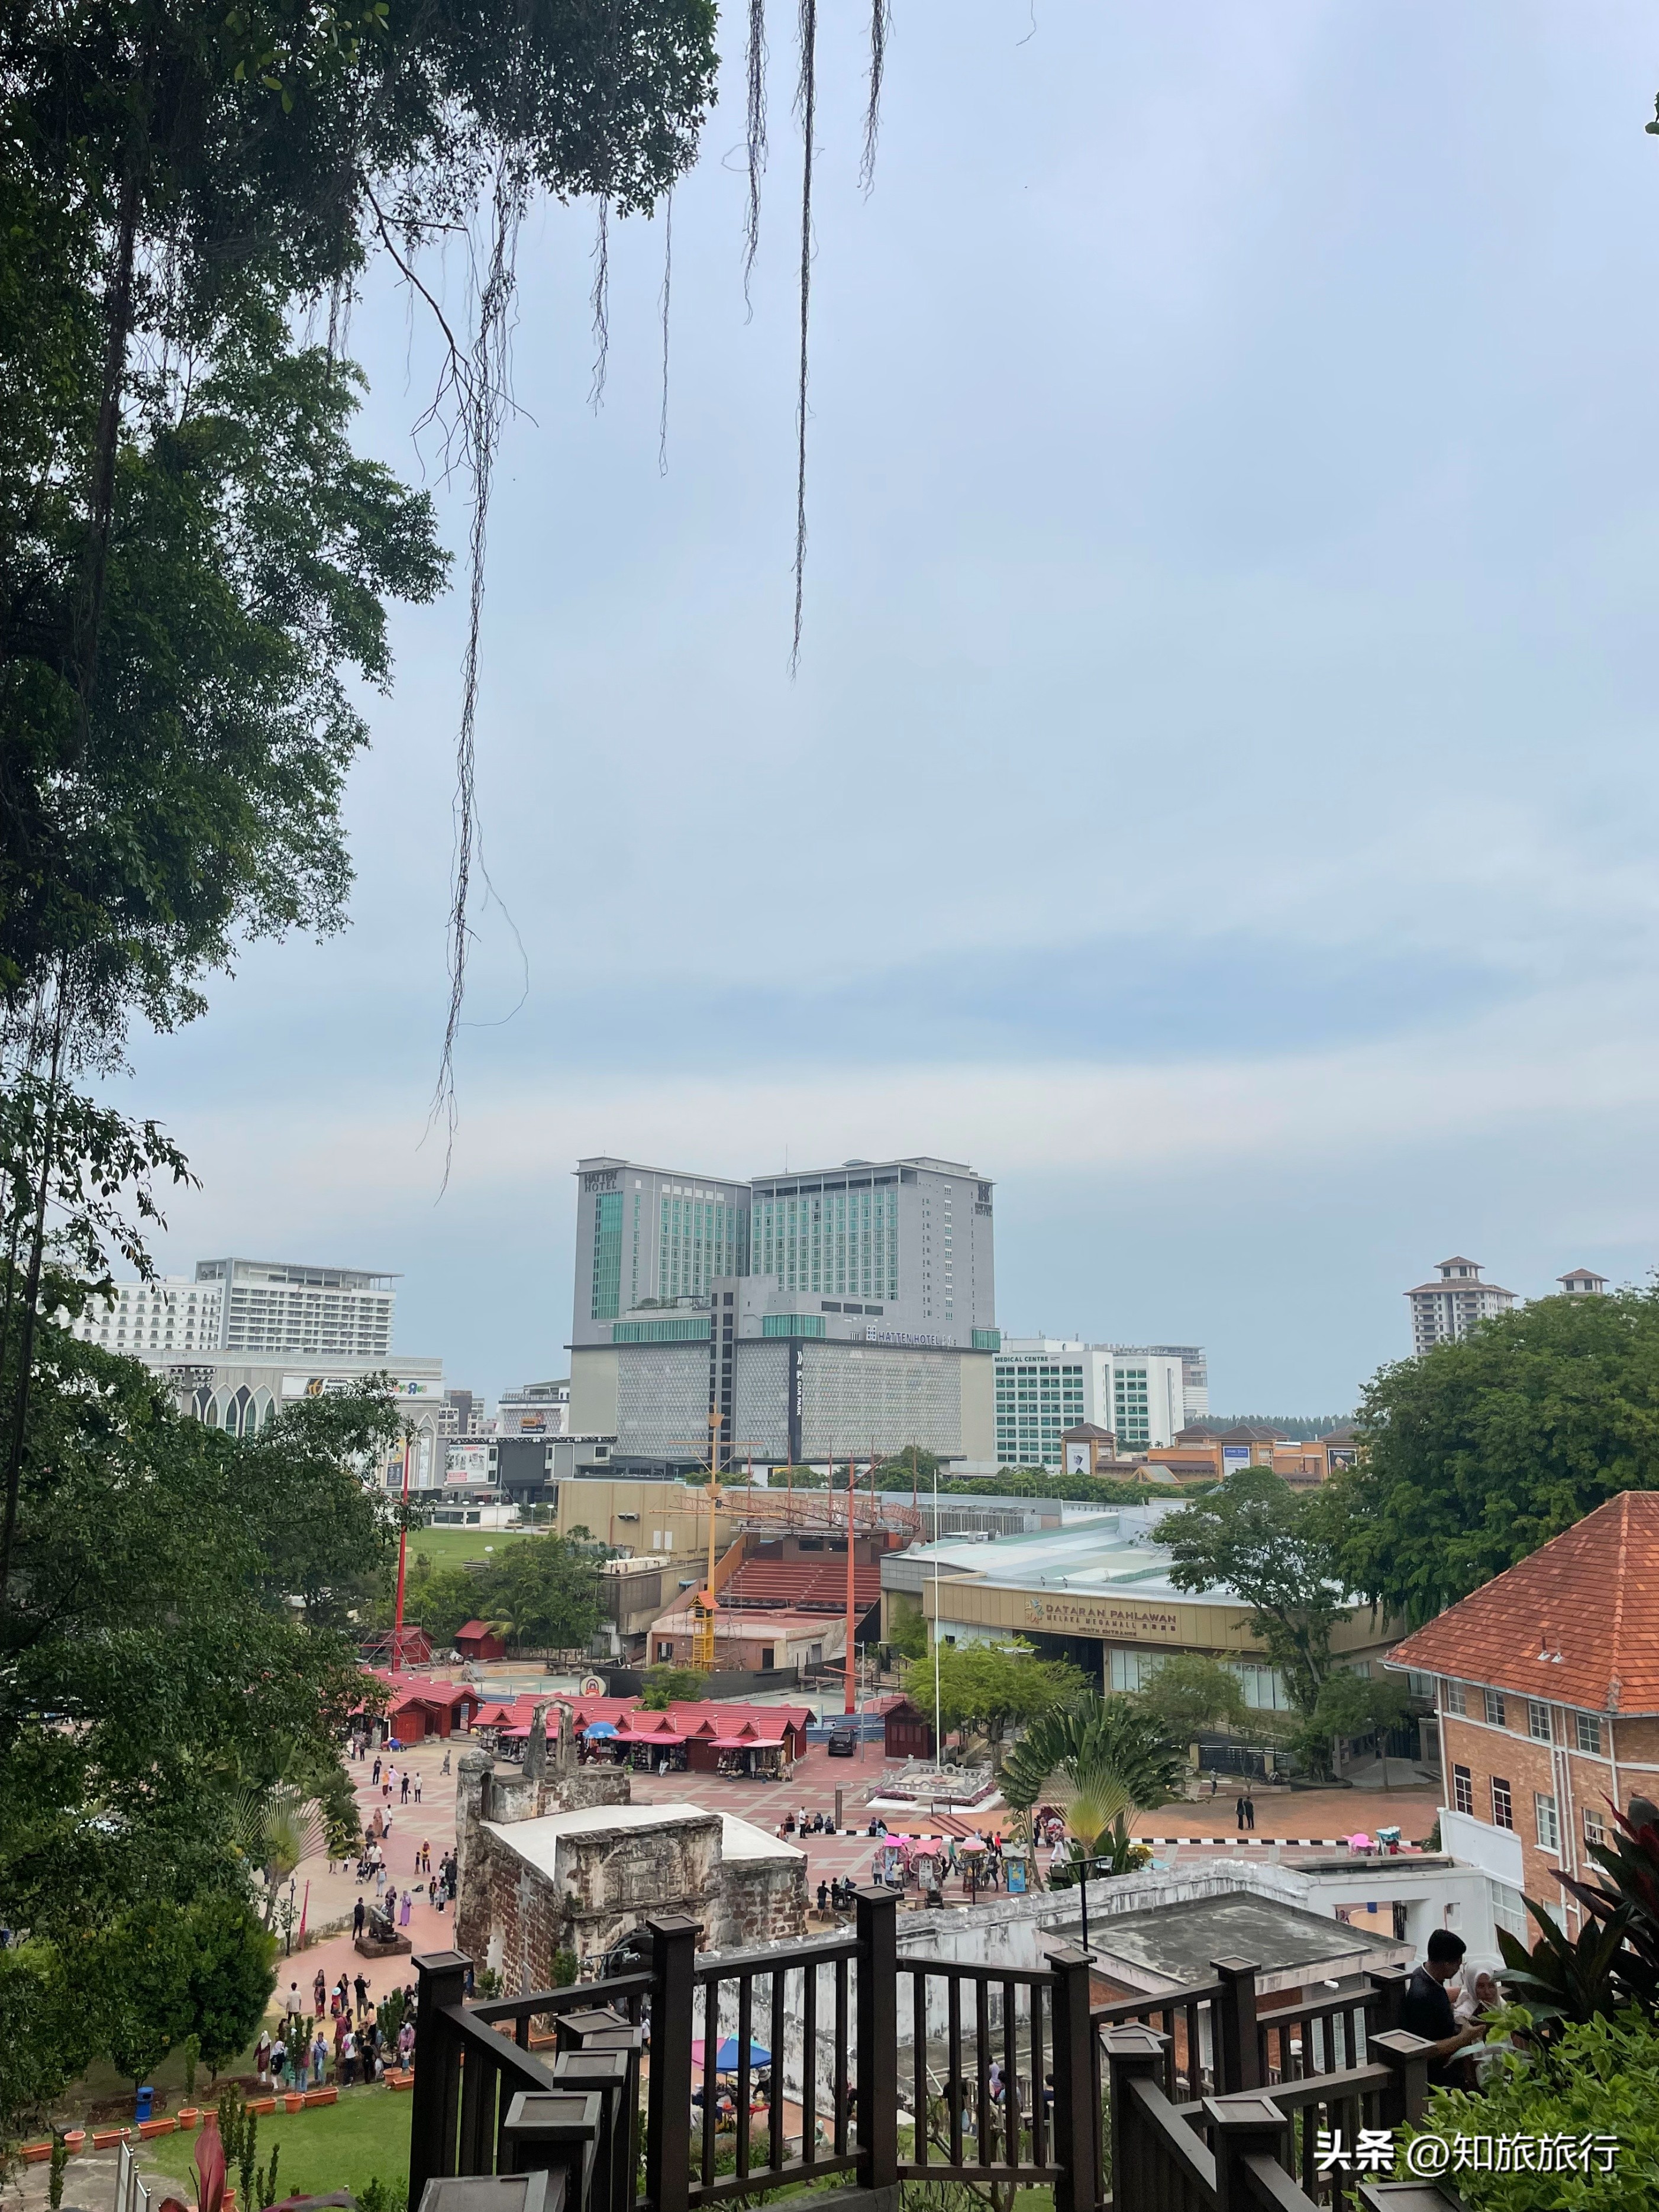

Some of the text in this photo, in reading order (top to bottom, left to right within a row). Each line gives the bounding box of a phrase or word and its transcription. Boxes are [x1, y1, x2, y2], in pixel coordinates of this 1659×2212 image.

[585, 1171, 618, 1183] HATTEN
[585, 1181, 616, 1192] HOTEL
[878, 1331, 912, 1344] HATTEN
[914, 1334, 940, 1345] HOTEL
[1046, 1604, 1176, 1623] DATARAN PAHLAWAN
[1086, 1618, 1136, 1629] MEGAMALL
